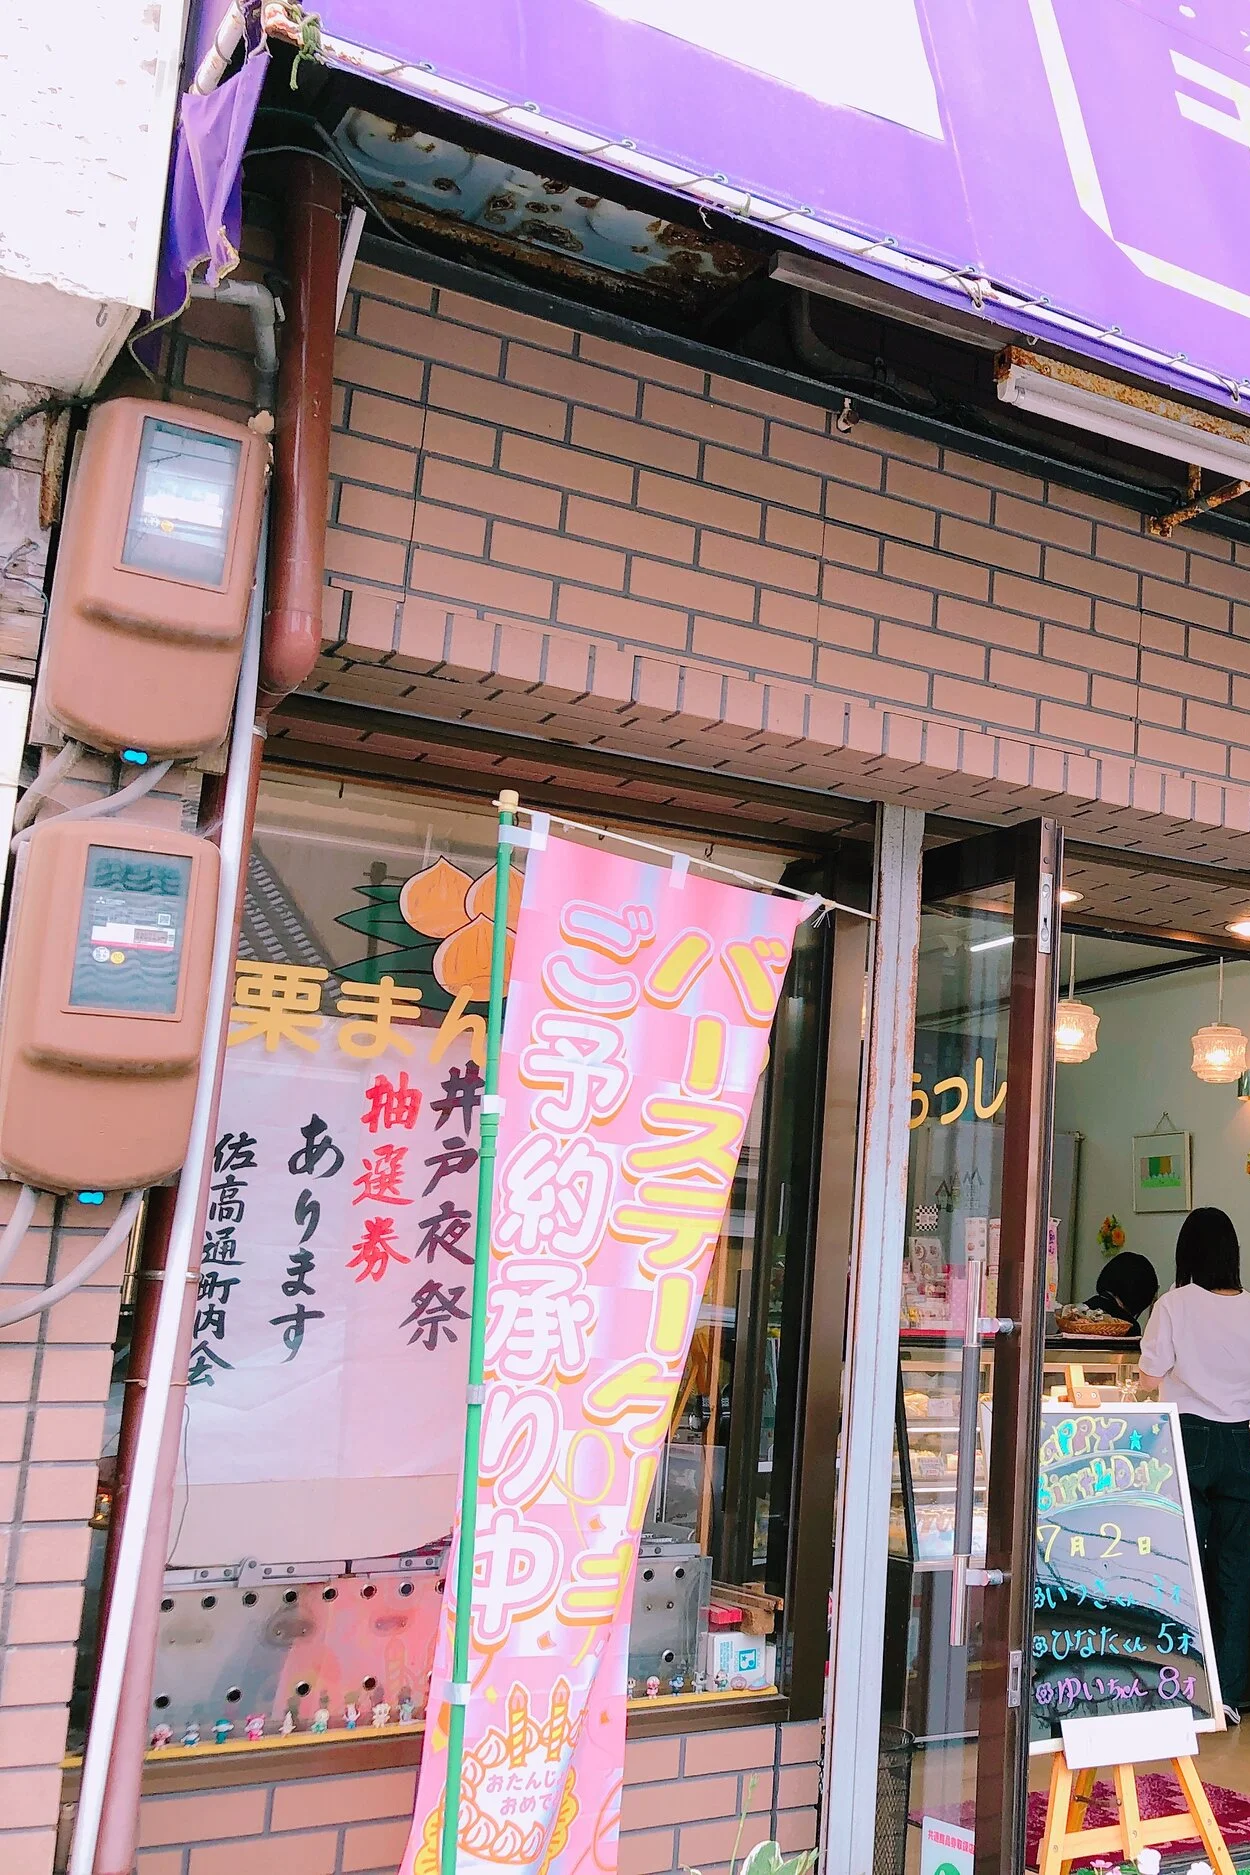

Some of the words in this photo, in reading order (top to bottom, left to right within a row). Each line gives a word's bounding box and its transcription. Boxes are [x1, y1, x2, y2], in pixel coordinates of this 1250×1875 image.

[188, 1131, 258, 1388] 佐高通町内会
[269, 1113, 344, 1363] あります
[344, 1071, 422, 1284] 抽選券
[398, 1060, 486, 1351] 井戸夜祭
[450, 899, 656, 1645] ご予約承り中
